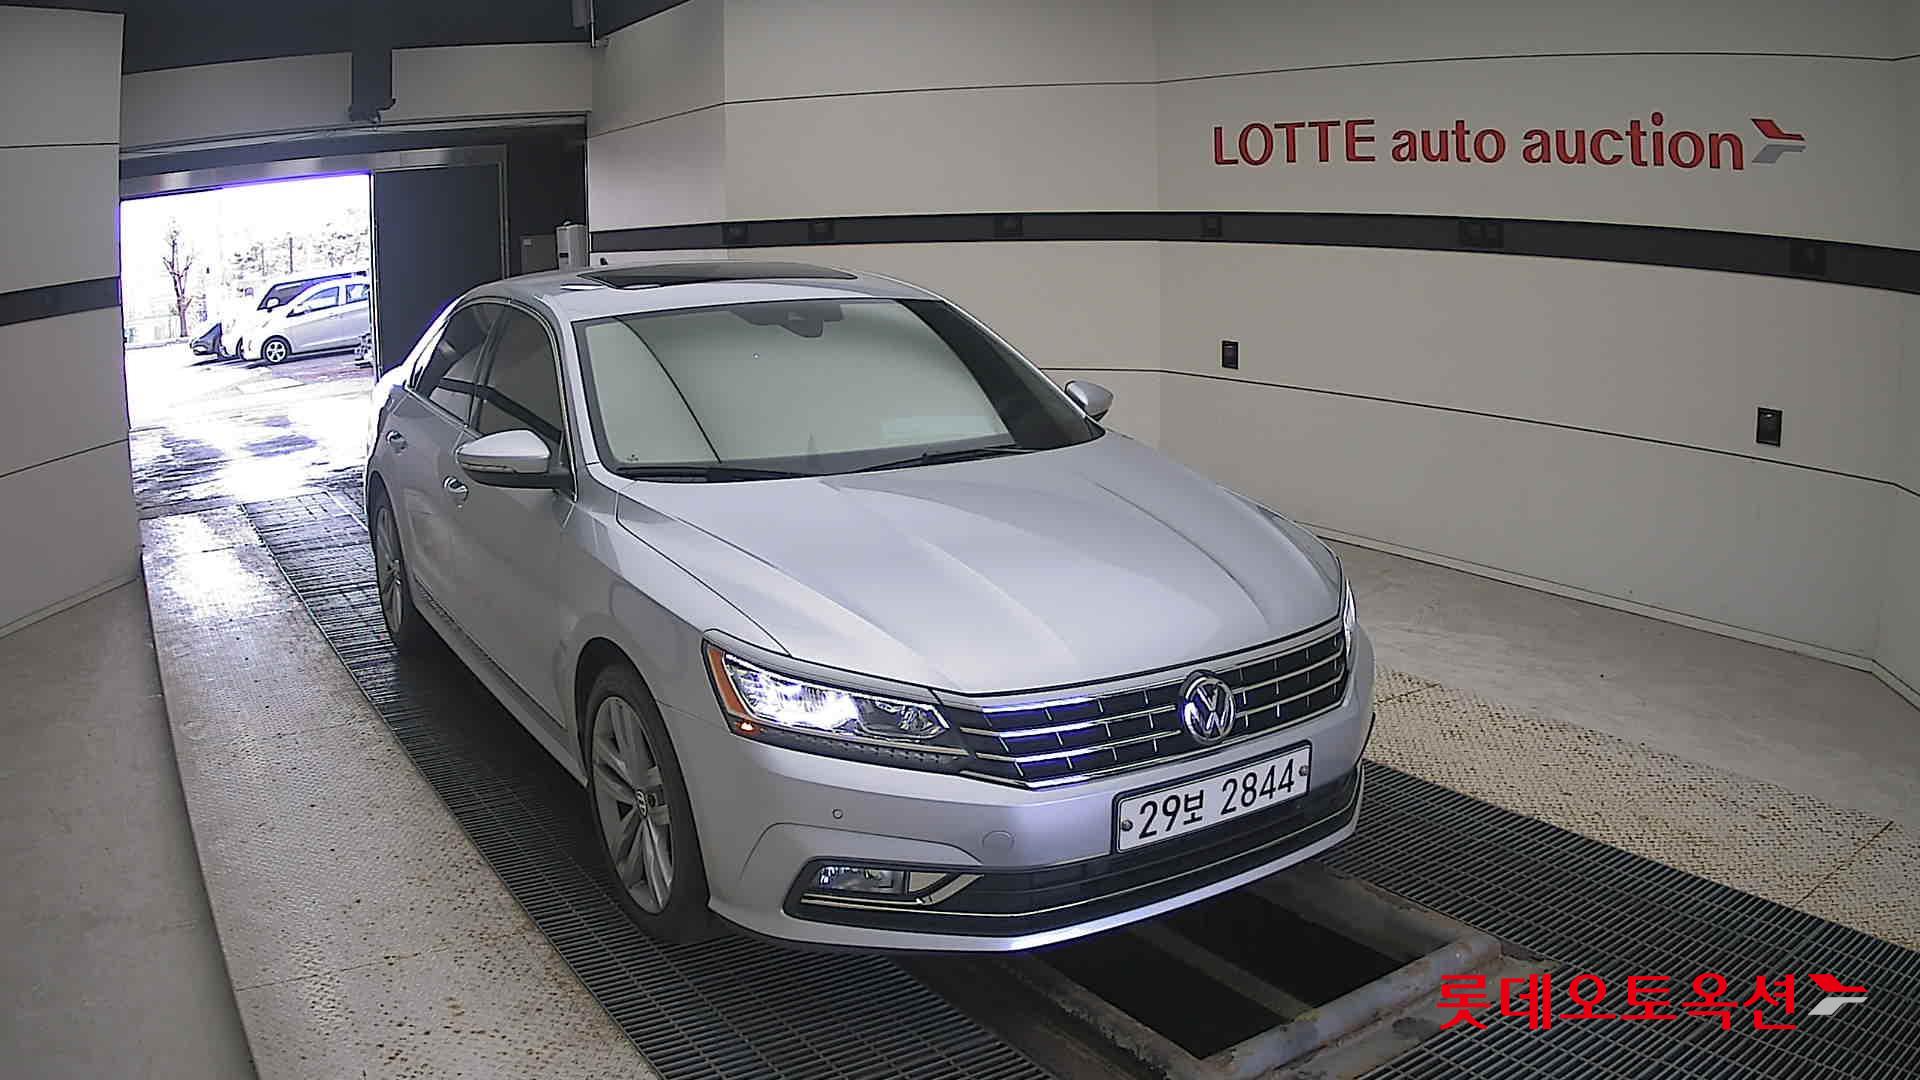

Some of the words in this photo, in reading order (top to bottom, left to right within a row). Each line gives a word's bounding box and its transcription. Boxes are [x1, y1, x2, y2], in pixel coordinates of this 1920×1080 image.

[1213, 119, 1376, 165] LOTTE
[1391, 119, 1506, 163] auto
[1522, 112, 1745, 170] auction
[1138, 789, 1204, 840] 29보
[1219, 758, 1295, 815] 2844
